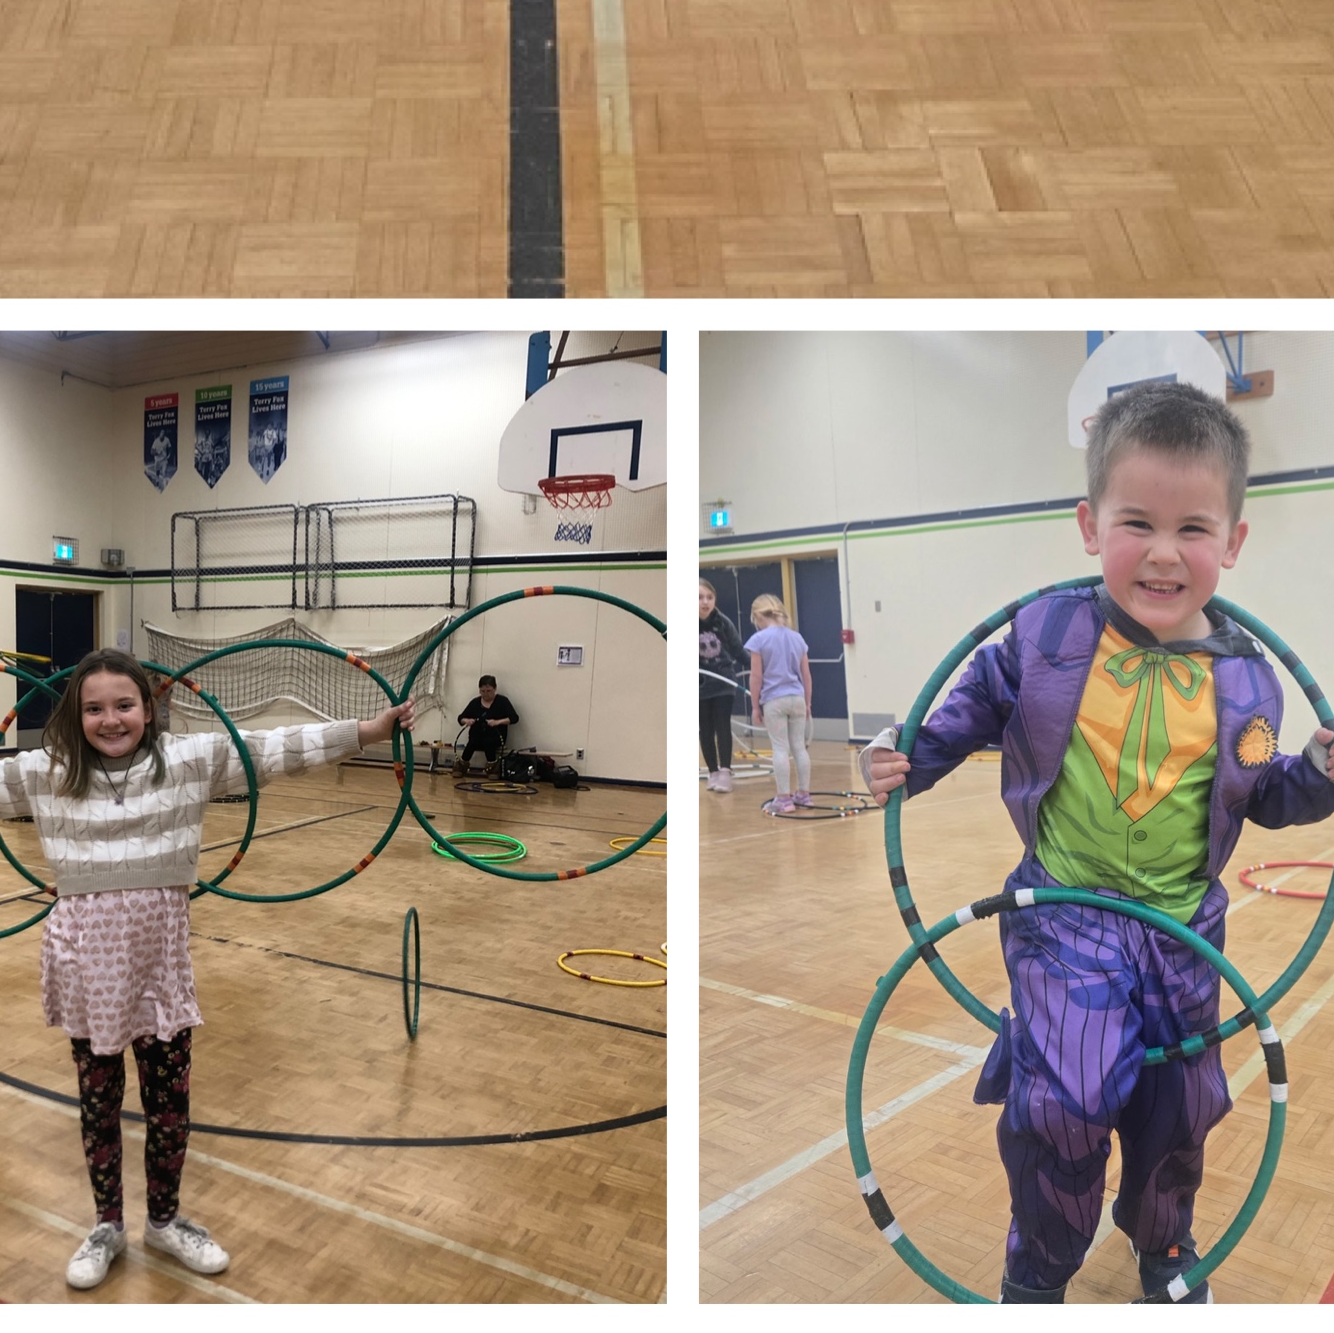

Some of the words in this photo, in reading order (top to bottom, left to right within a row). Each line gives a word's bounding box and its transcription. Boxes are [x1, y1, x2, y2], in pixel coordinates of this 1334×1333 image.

[255, 383, 263, 391] 15
[263, 380, 285, 390] years
[208, 390, 228, 400] years
[155, 398, 173, 408] years
[254, 397, 271, 406] Terry
[272, 395, 284, 403] Fox
[199, 406, 215, 414] Terry
[252, 405, 270, 413] Lives
[270, 402, 286, 411] Here
[148, 413, 163, 422] Terry
[198, 413, 214, 421] Lives
[215, 410, 229, 419] Here
[146, 420, 162, 428] Lives
